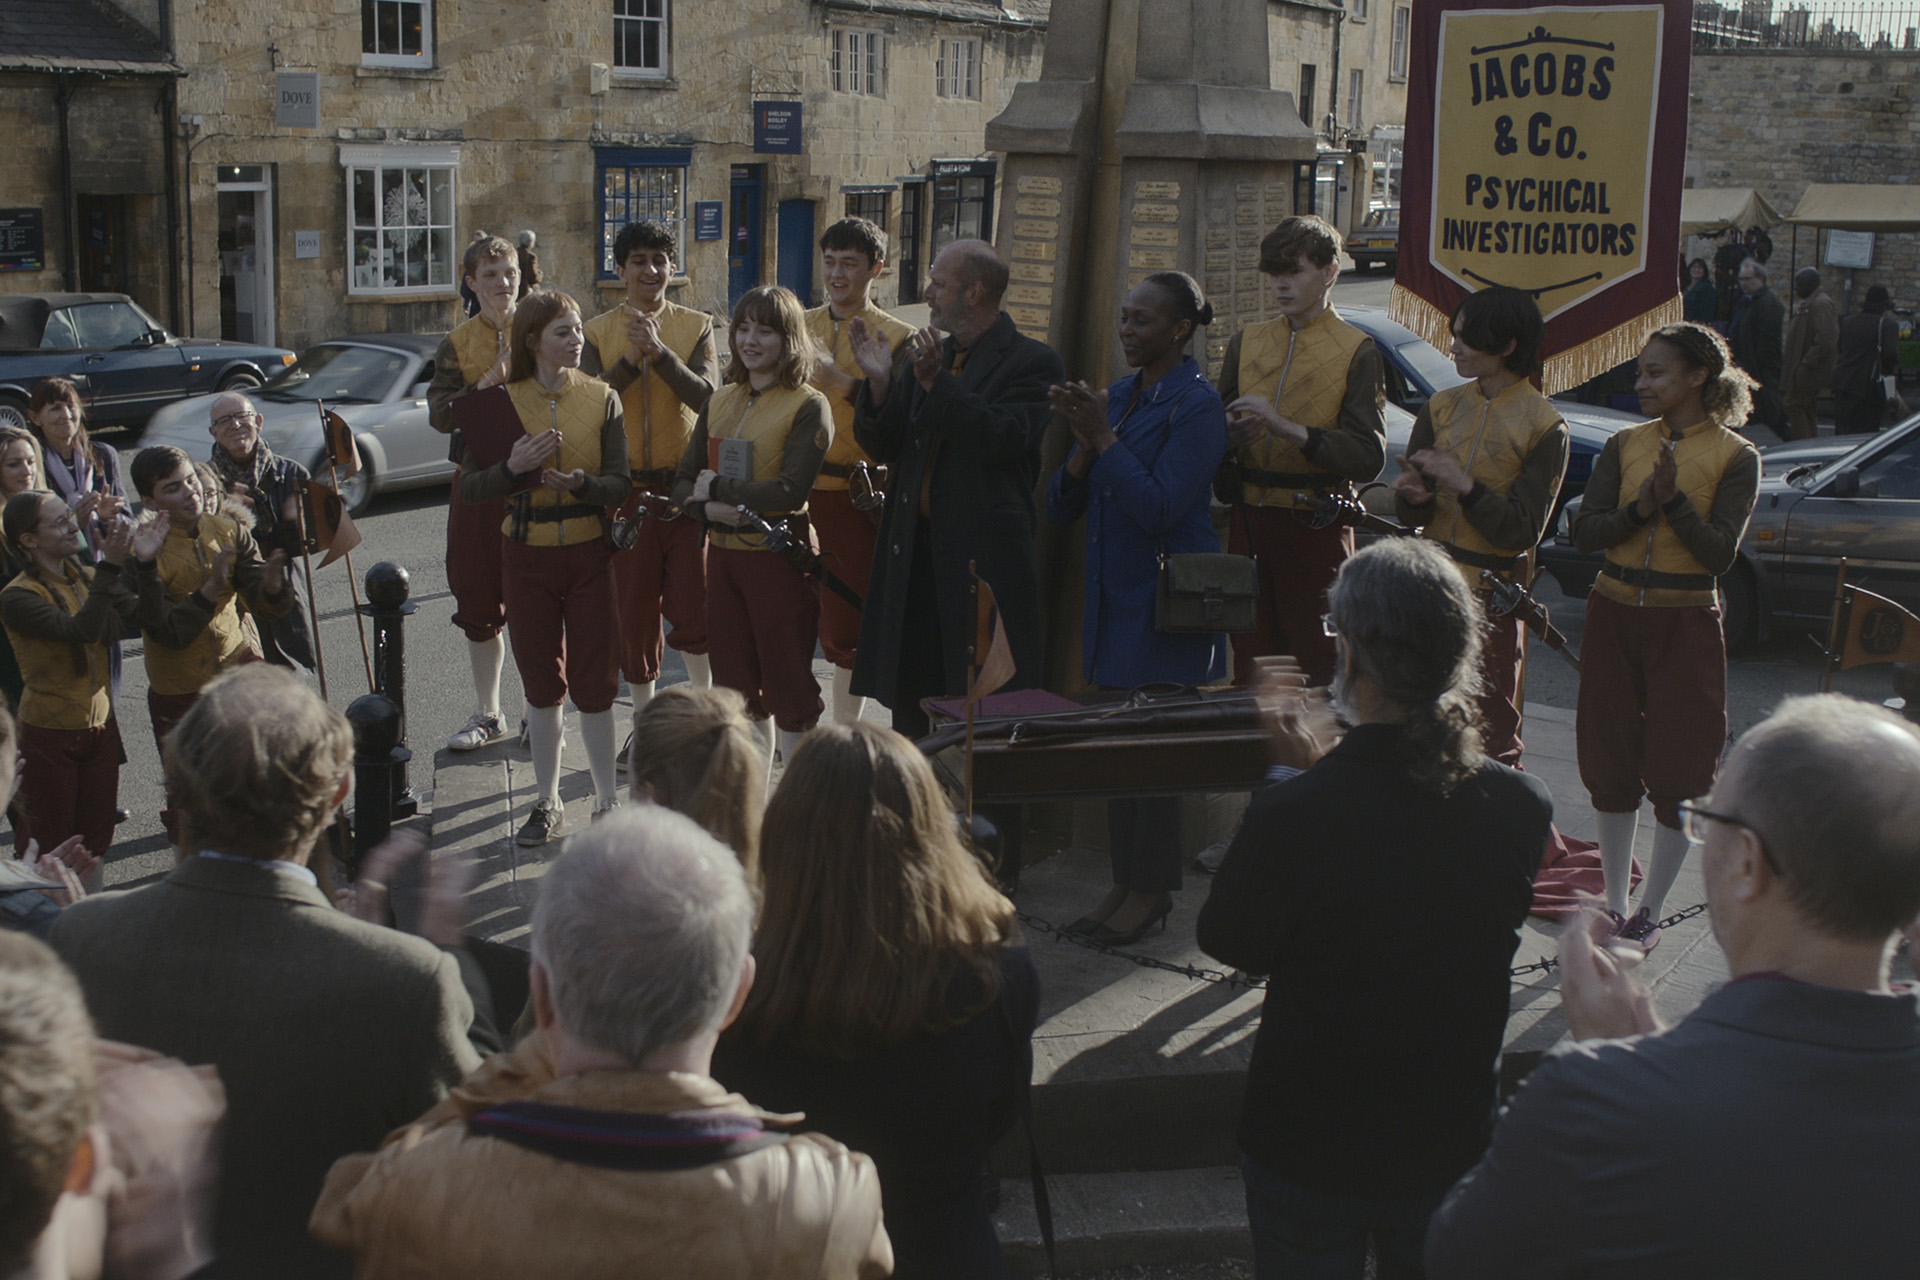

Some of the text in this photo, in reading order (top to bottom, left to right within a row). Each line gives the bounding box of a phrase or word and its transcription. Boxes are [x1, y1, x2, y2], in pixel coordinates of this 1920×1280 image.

[282, 91, 312, 104] DOVE
[1470, 52, 1615, 106] JACOBS
[1494, 115, 1518, 156] &
[1465, 173, 1610, 214] PSYCHICAL
[298, 239, 318, 247] DOVE
[1442, 218, 1637, 256] INVESTIGATORS
